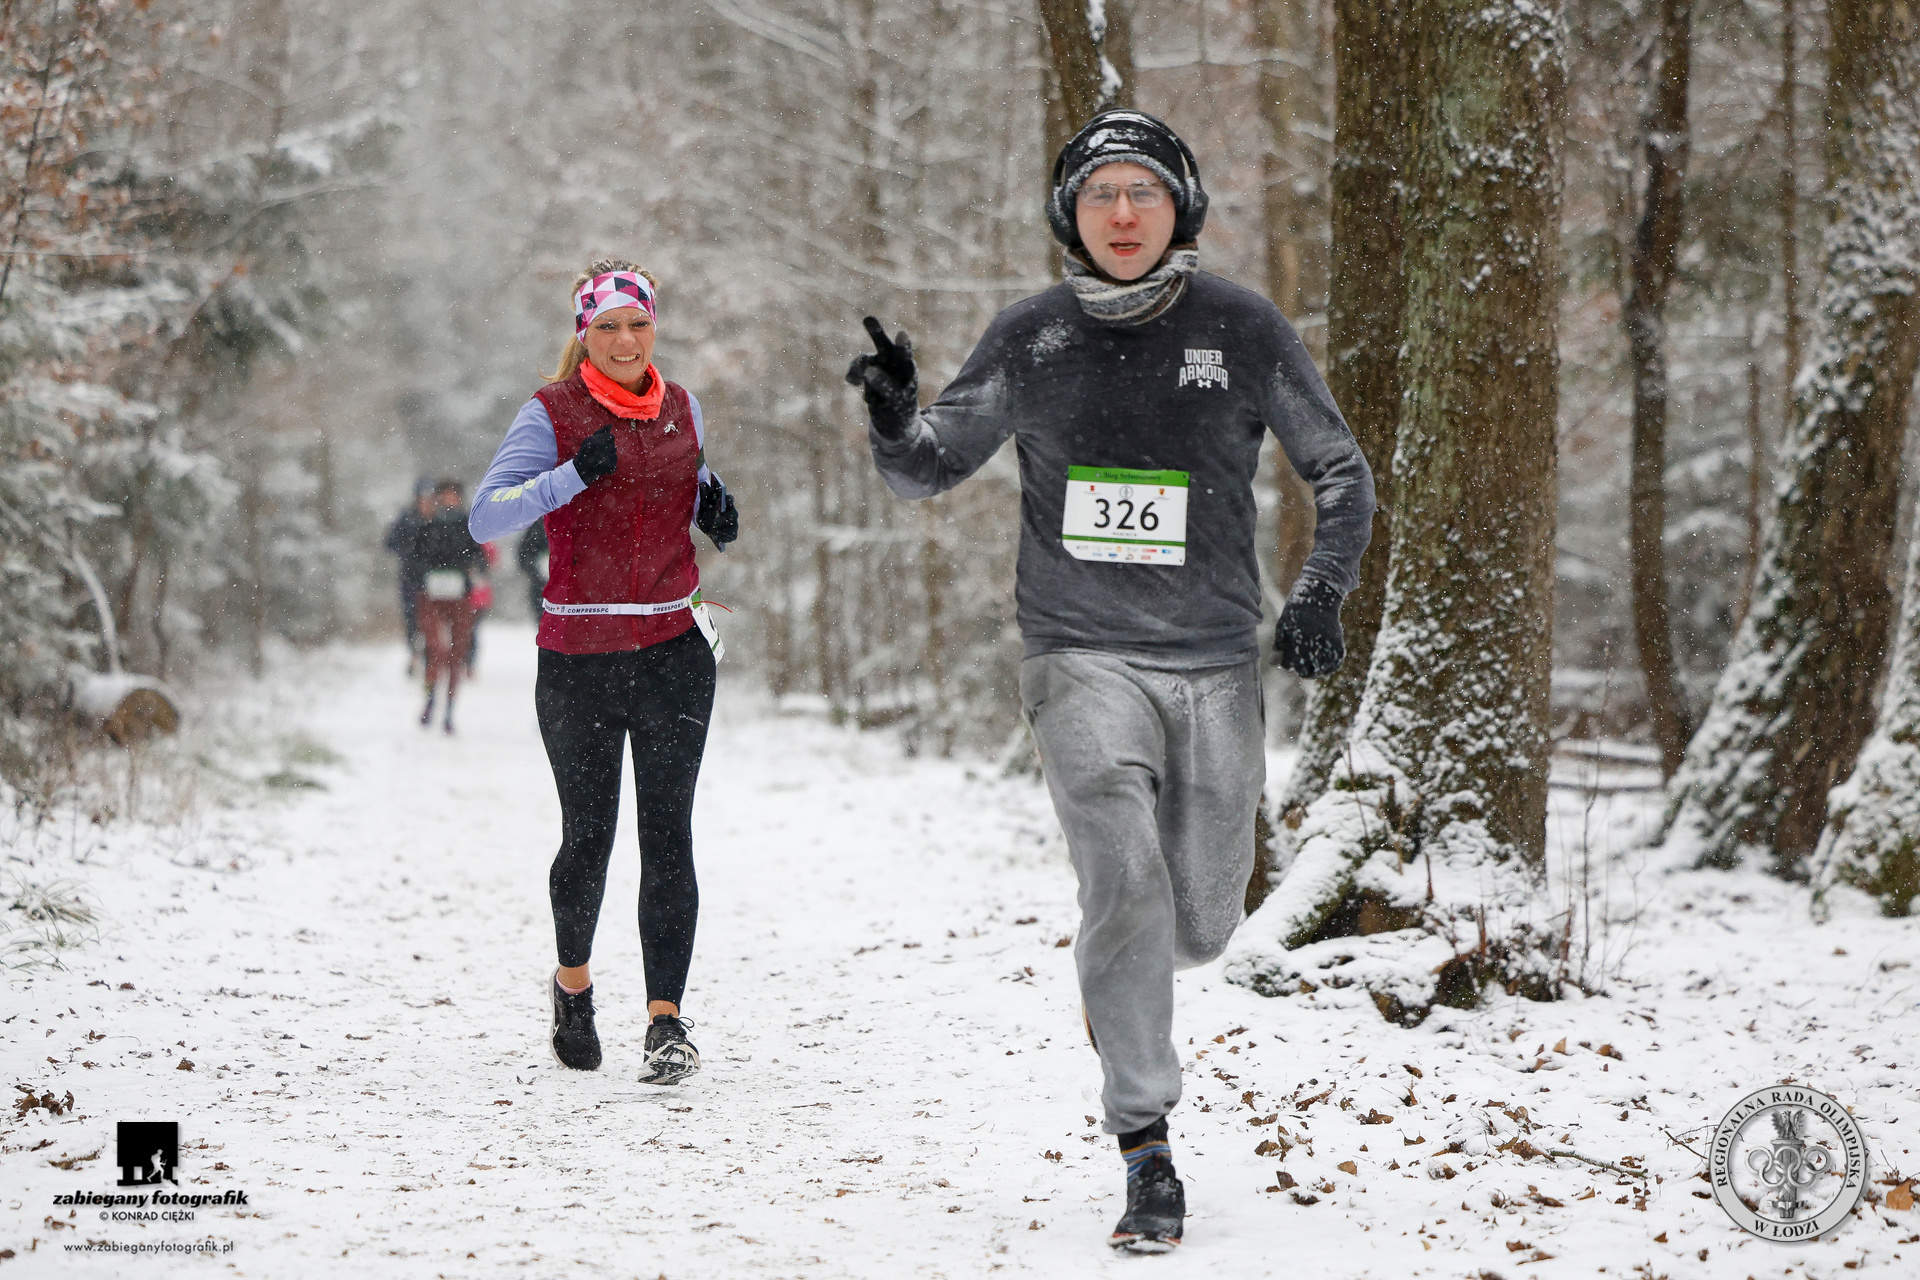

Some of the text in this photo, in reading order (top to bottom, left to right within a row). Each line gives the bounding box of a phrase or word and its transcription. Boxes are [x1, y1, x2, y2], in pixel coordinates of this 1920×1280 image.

[1184, 348, 1223, 366] UNDER
[1178, 364, 1229, 391] ARMOUR
[1094, 498, 1159, 531] 326
